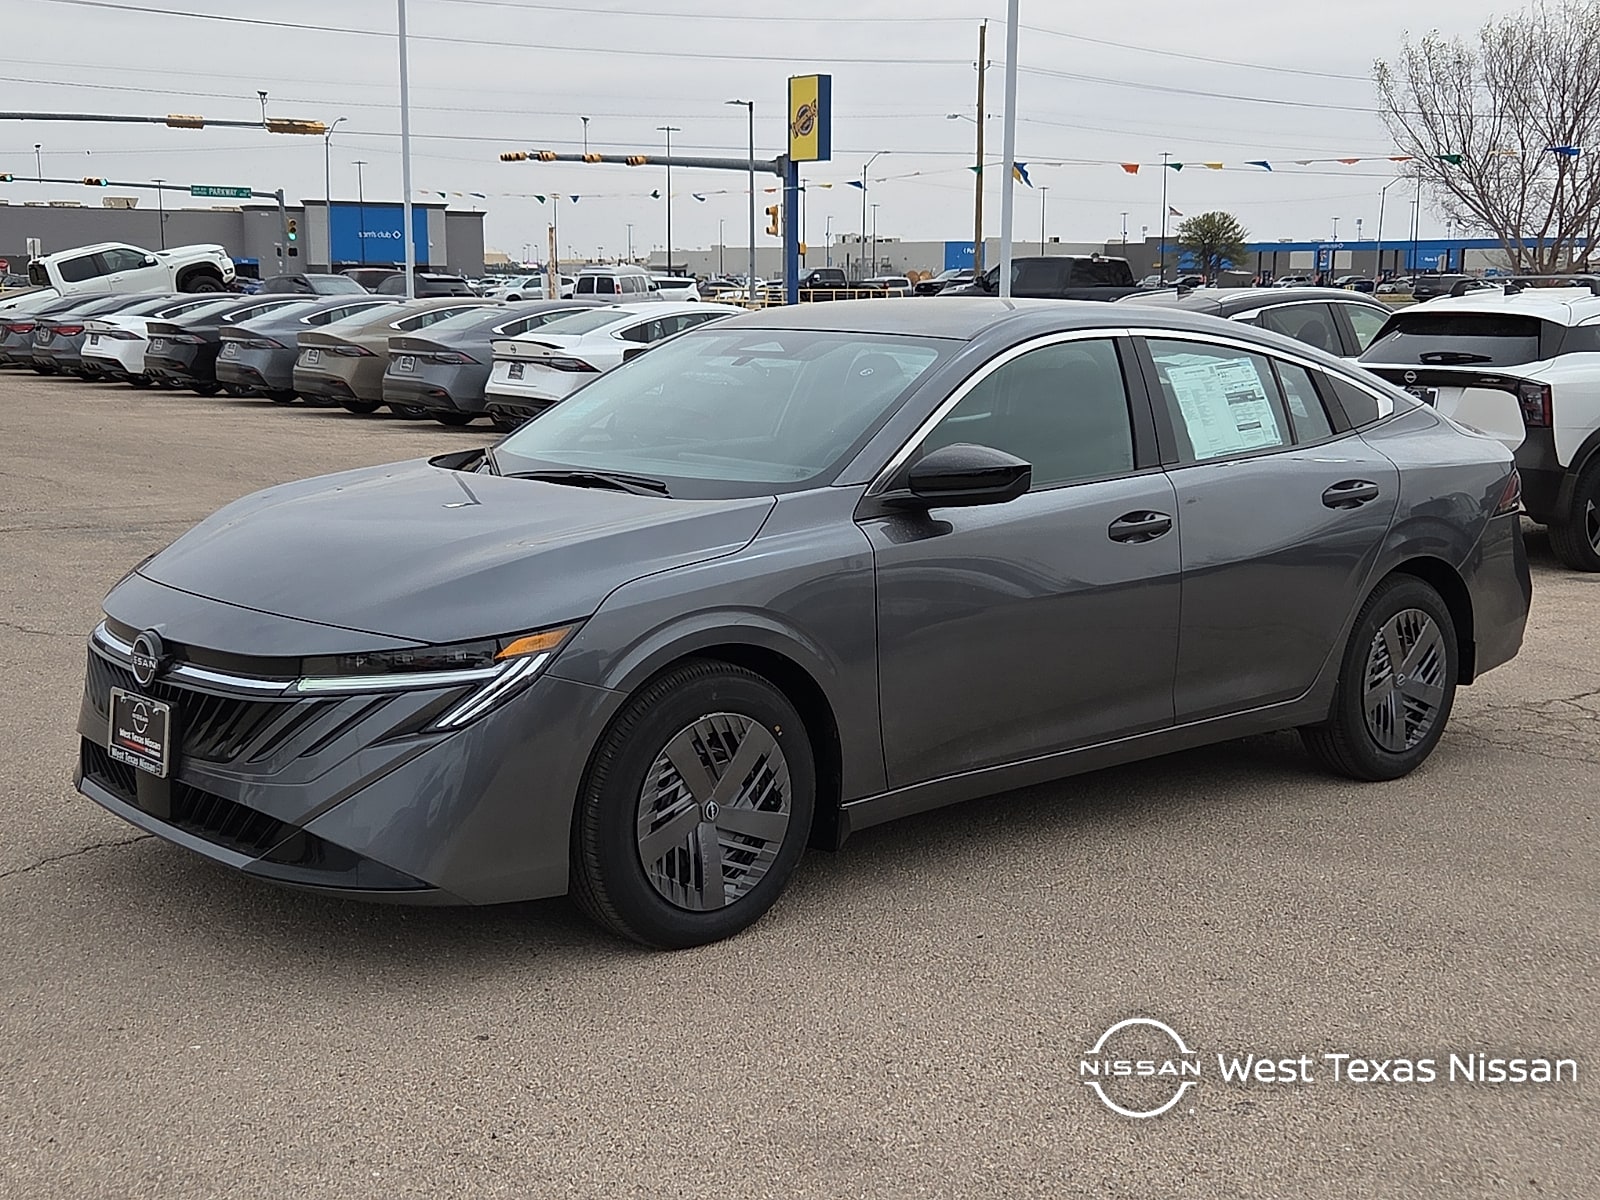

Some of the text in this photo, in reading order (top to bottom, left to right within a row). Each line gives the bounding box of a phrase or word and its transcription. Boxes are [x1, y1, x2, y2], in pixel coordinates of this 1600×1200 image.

[209, 187, 237, 196] PARKWAY
[377, 231, 391, 239] club
[119, 727, 161, 750] West Texas Nissan
[111, 747, 125, 760] West
[125, 751, 139, 765] Texas
[139, 757, 156, 773] Nissan
